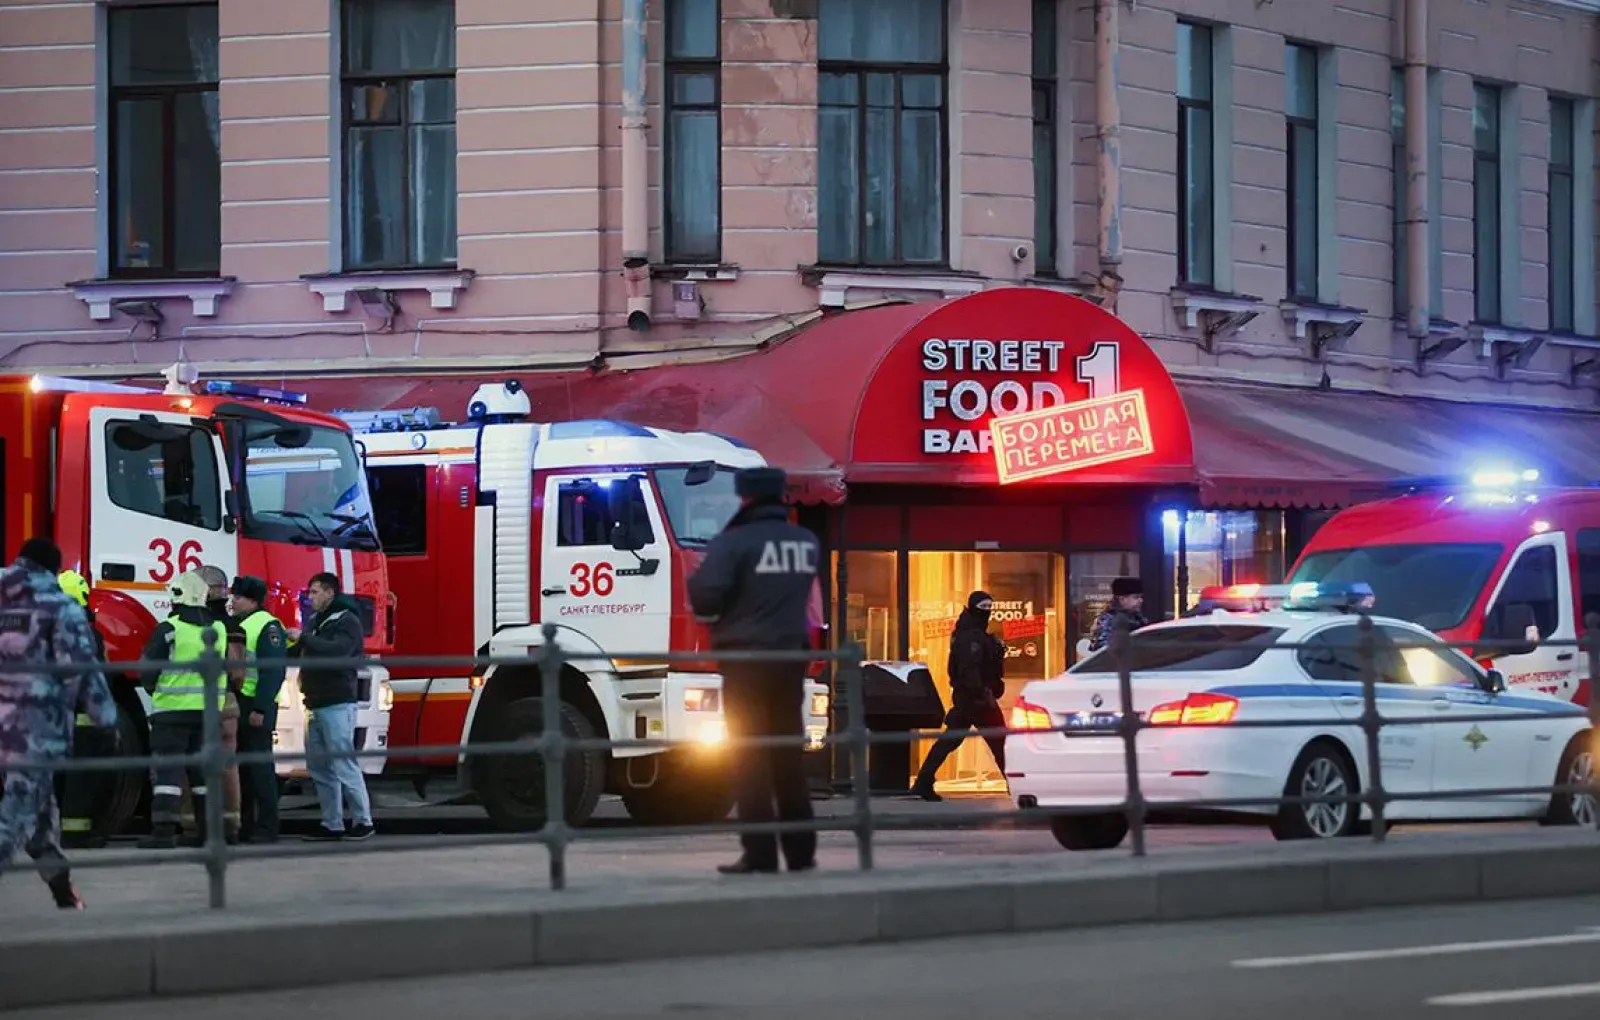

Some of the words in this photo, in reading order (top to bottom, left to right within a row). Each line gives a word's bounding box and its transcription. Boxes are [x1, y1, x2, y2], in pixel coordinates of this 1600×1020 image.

[923, 339, 1064, 371] STREET
[1077, 342, 1120, 400] 1
[923, 380, 1065, 420] FOOD
[1001, 401, 1136, 447] БОЛЬШАЯ
[1005, 427, 1142, 469] ПЕРЕМЕНА
[149, 538, 203, 582] 36
[755, 541, 816, 573] ДПС
[570, 562, 614, 597] 36
[560, 604, 646, 615] САНКТ-ПЕТЕРБУРГ
